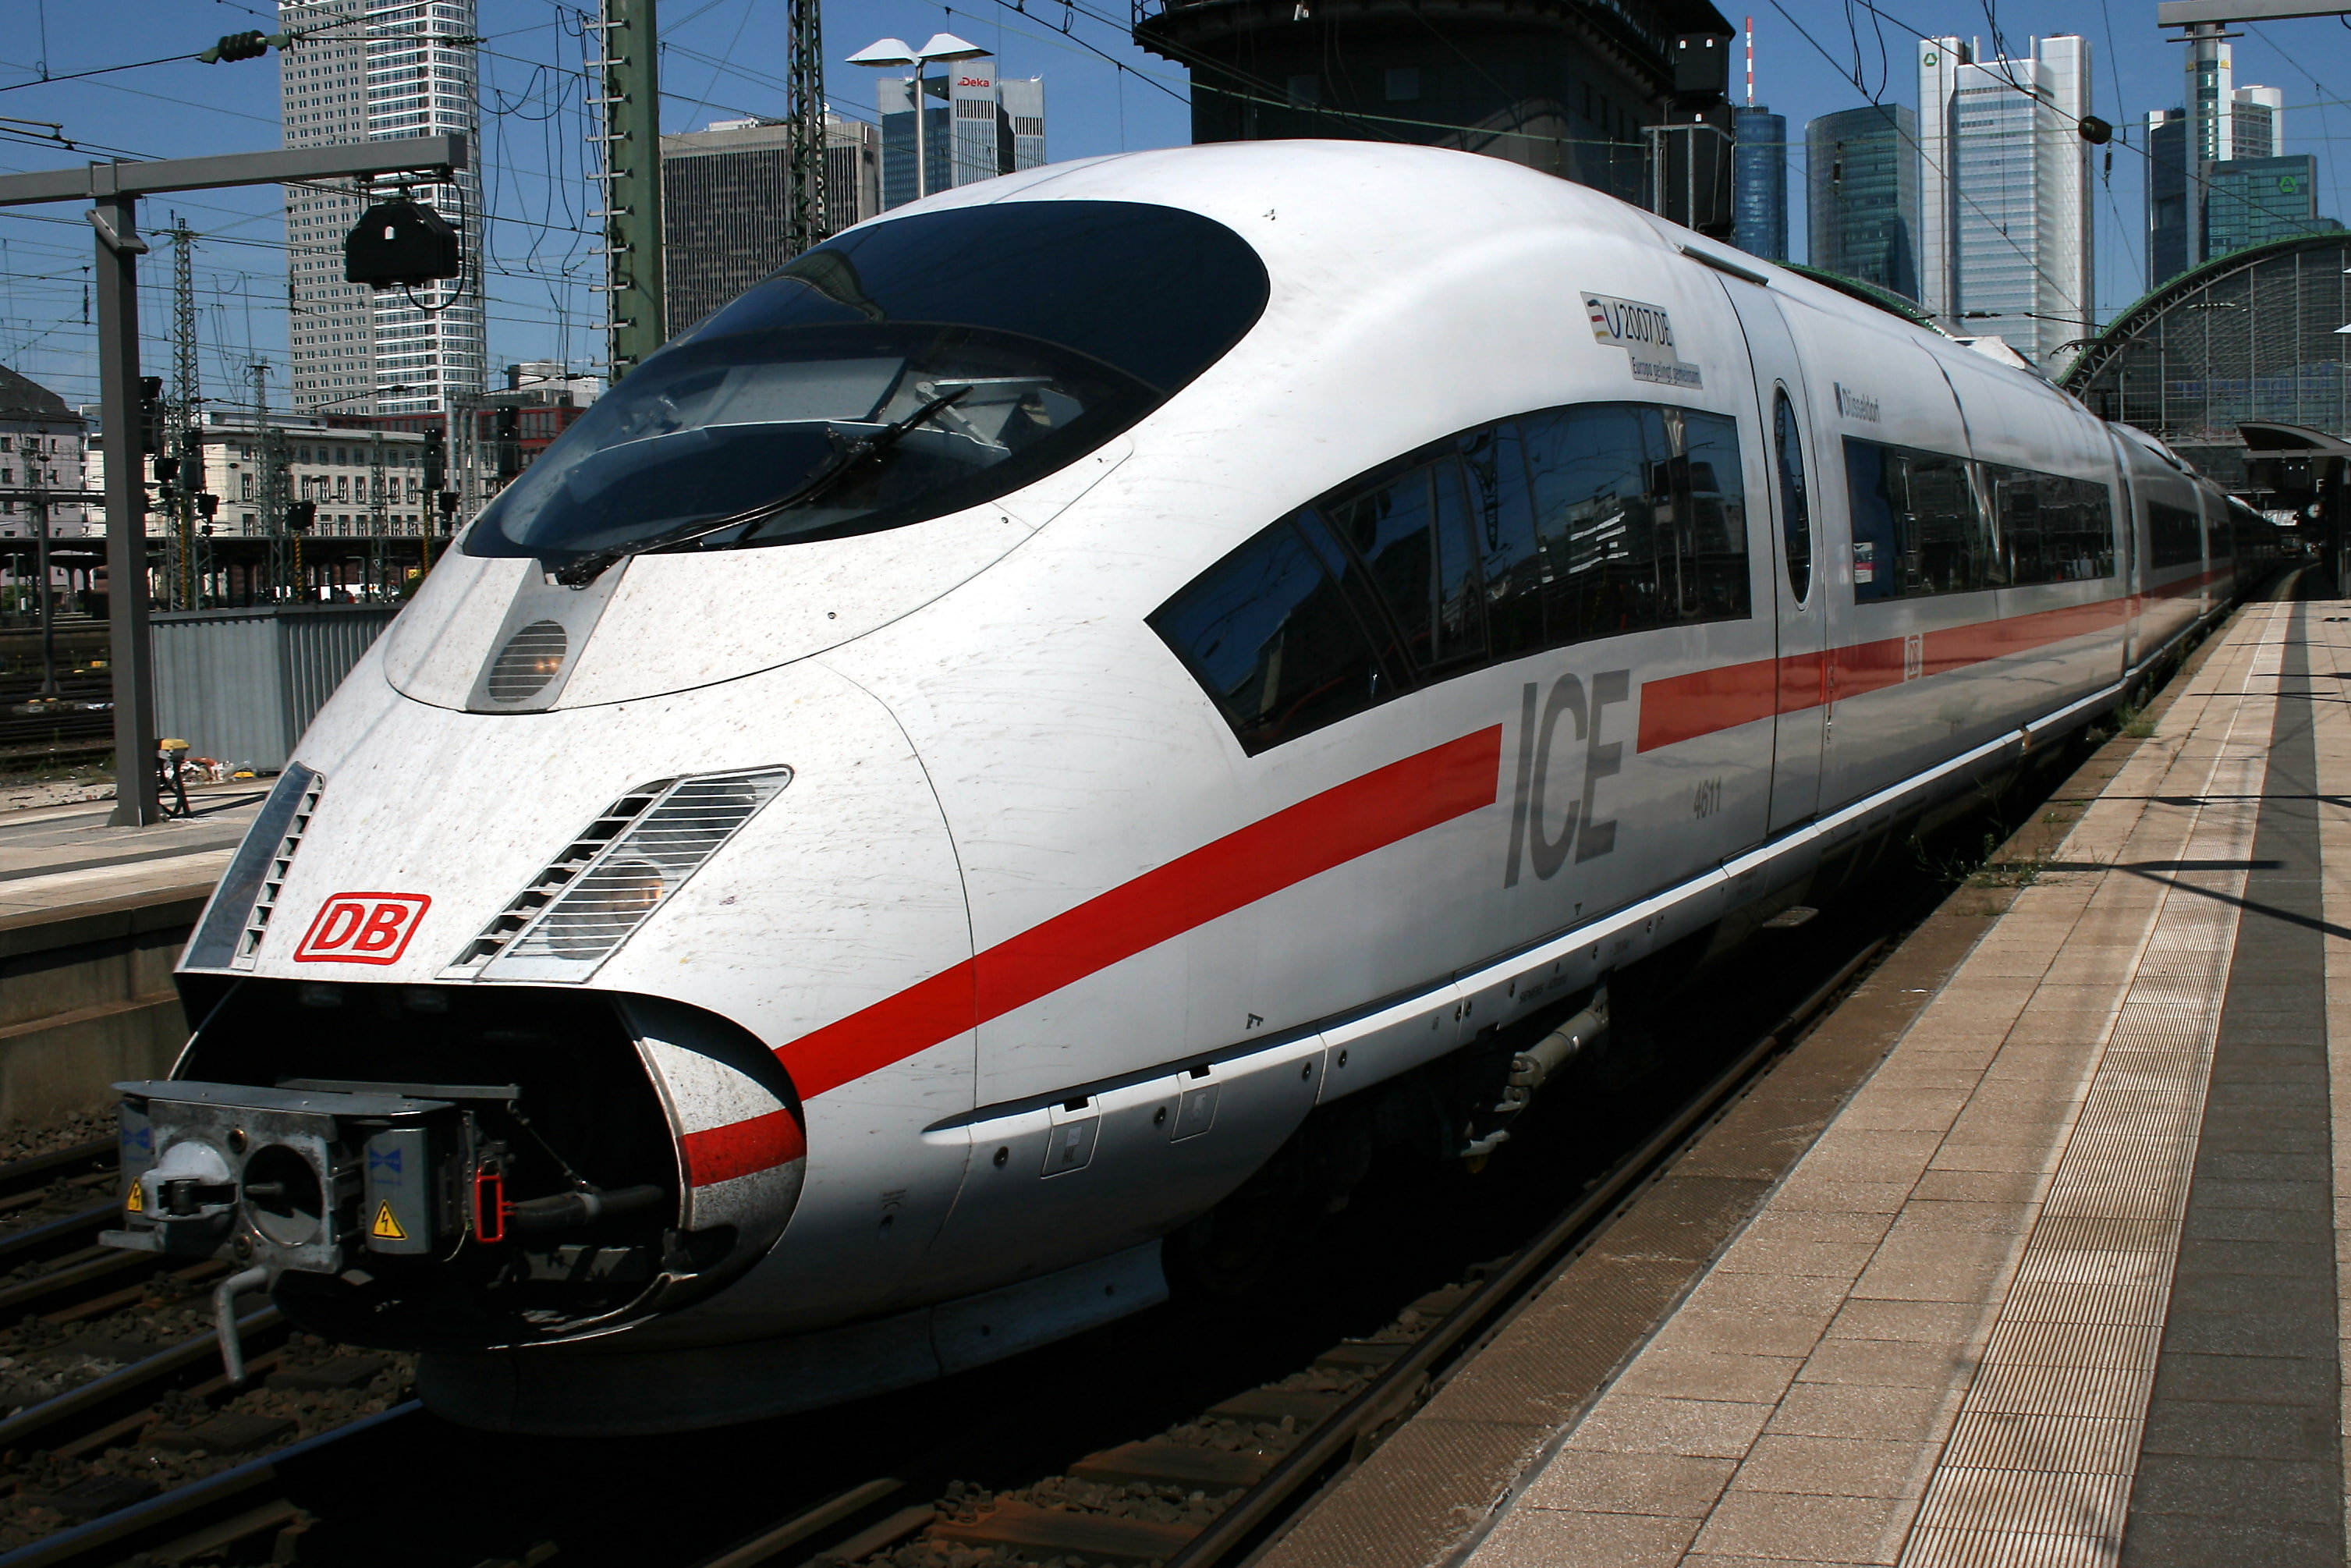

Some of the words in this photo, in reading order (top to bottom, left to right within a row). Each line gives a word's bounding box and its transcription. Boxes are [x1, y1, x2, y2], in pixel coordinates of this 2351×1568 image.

[962, 77, 989, 87] Deka
[2316, 479, 2325, 493] F
[1504, 669, 1630, 889] ICE
[1693, 775, 1722, 820] 4611
[310, 903, 409, 951] DB
